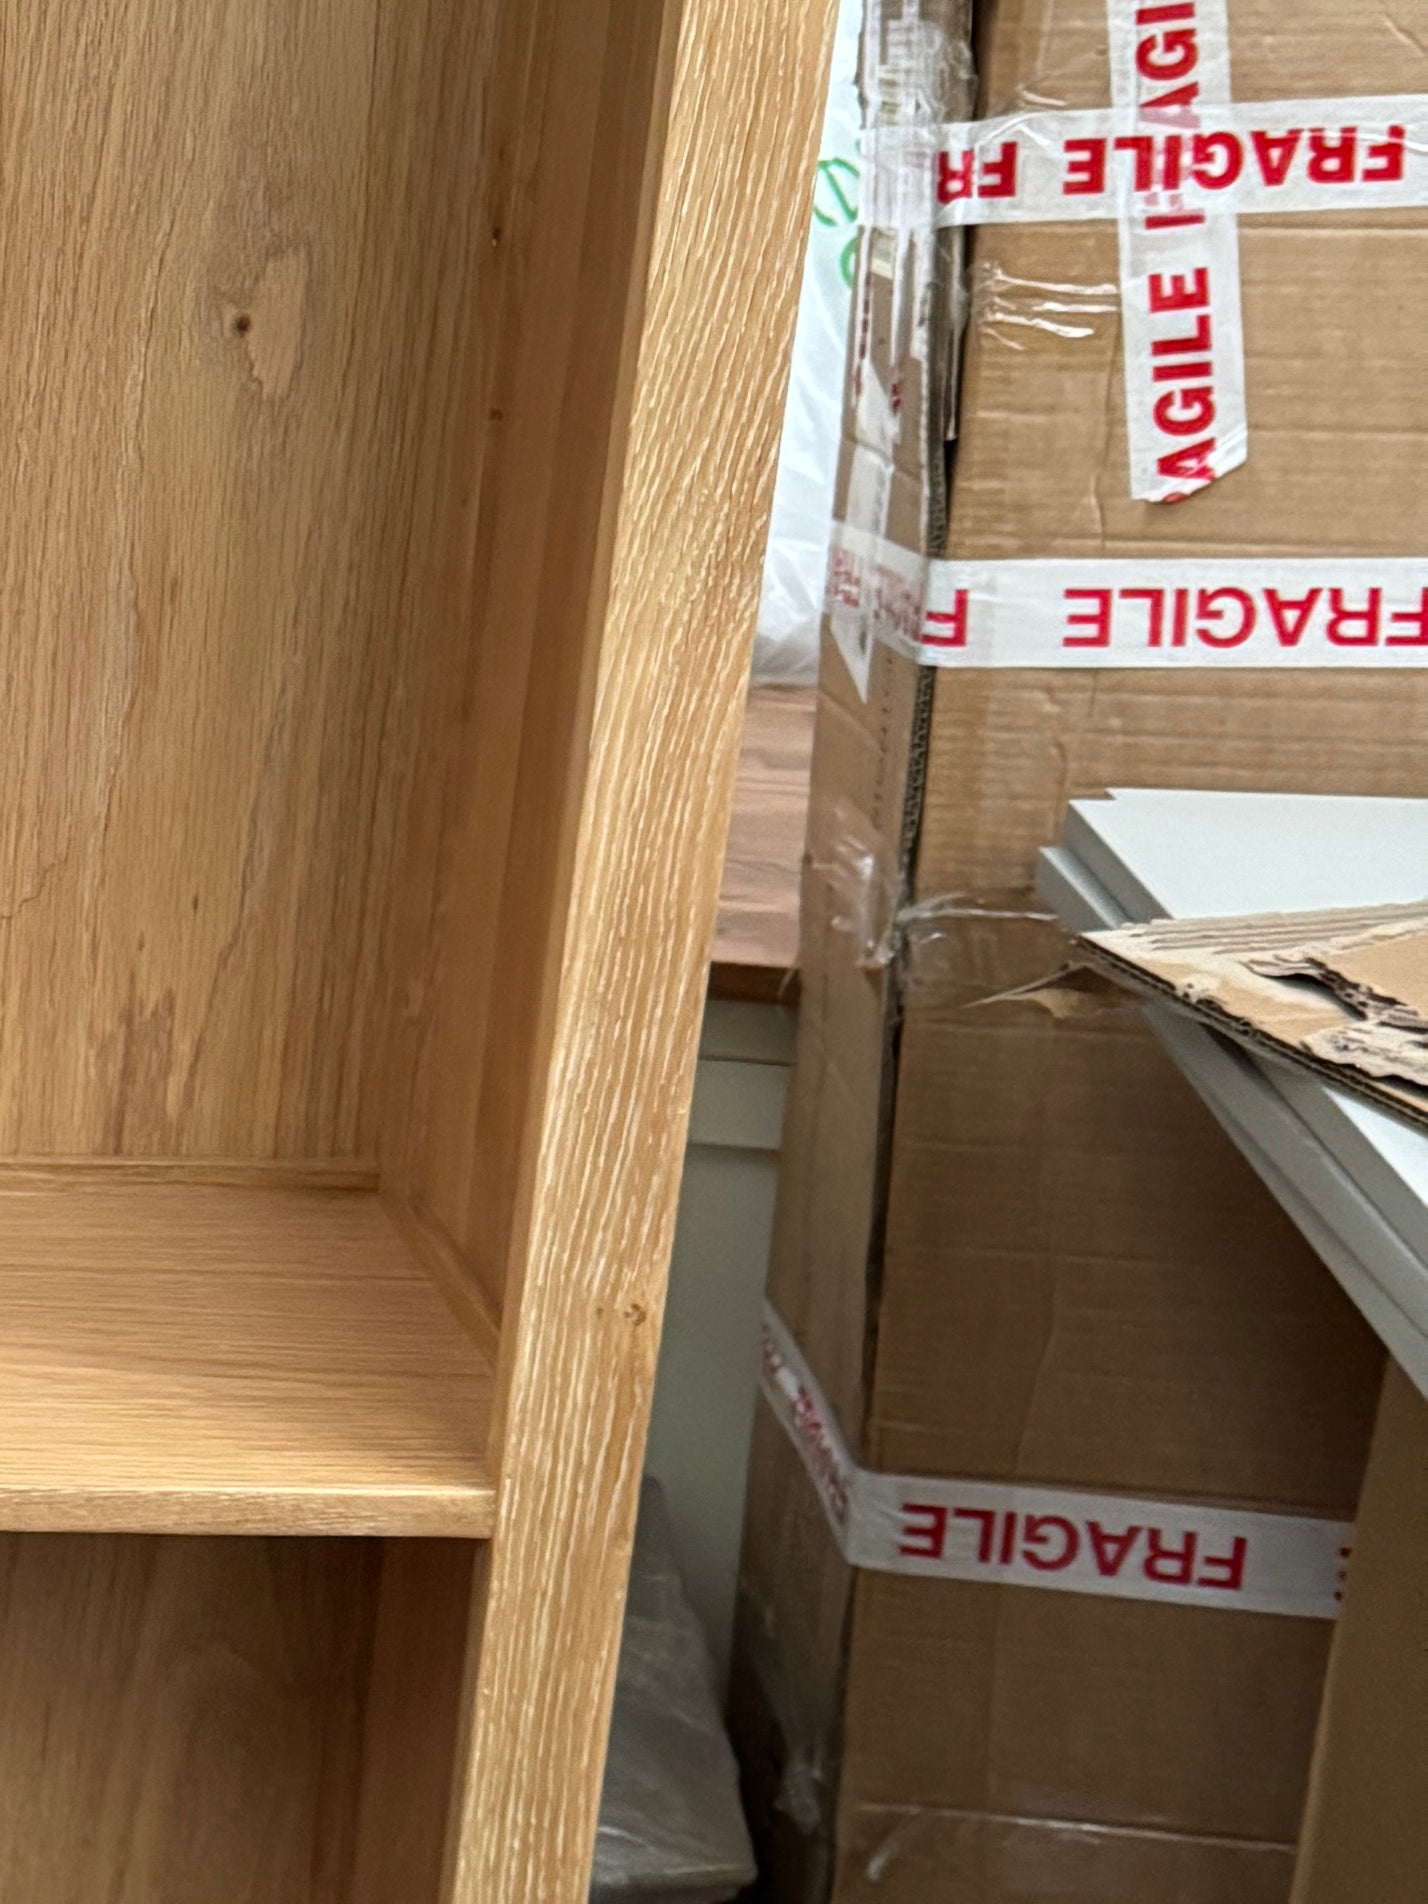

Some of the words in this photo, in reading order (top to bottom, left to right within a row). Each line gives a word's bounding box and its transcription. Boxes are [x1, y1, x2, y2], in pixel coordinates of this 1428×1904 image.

[1062, 125, 1406, 195] FRAGILE
[1147, 267, 1217, 505] AGILE
[1062, 586, 1428, 648] FRAGILE
[899, 1503, 1248, 1591] FRAGILE
